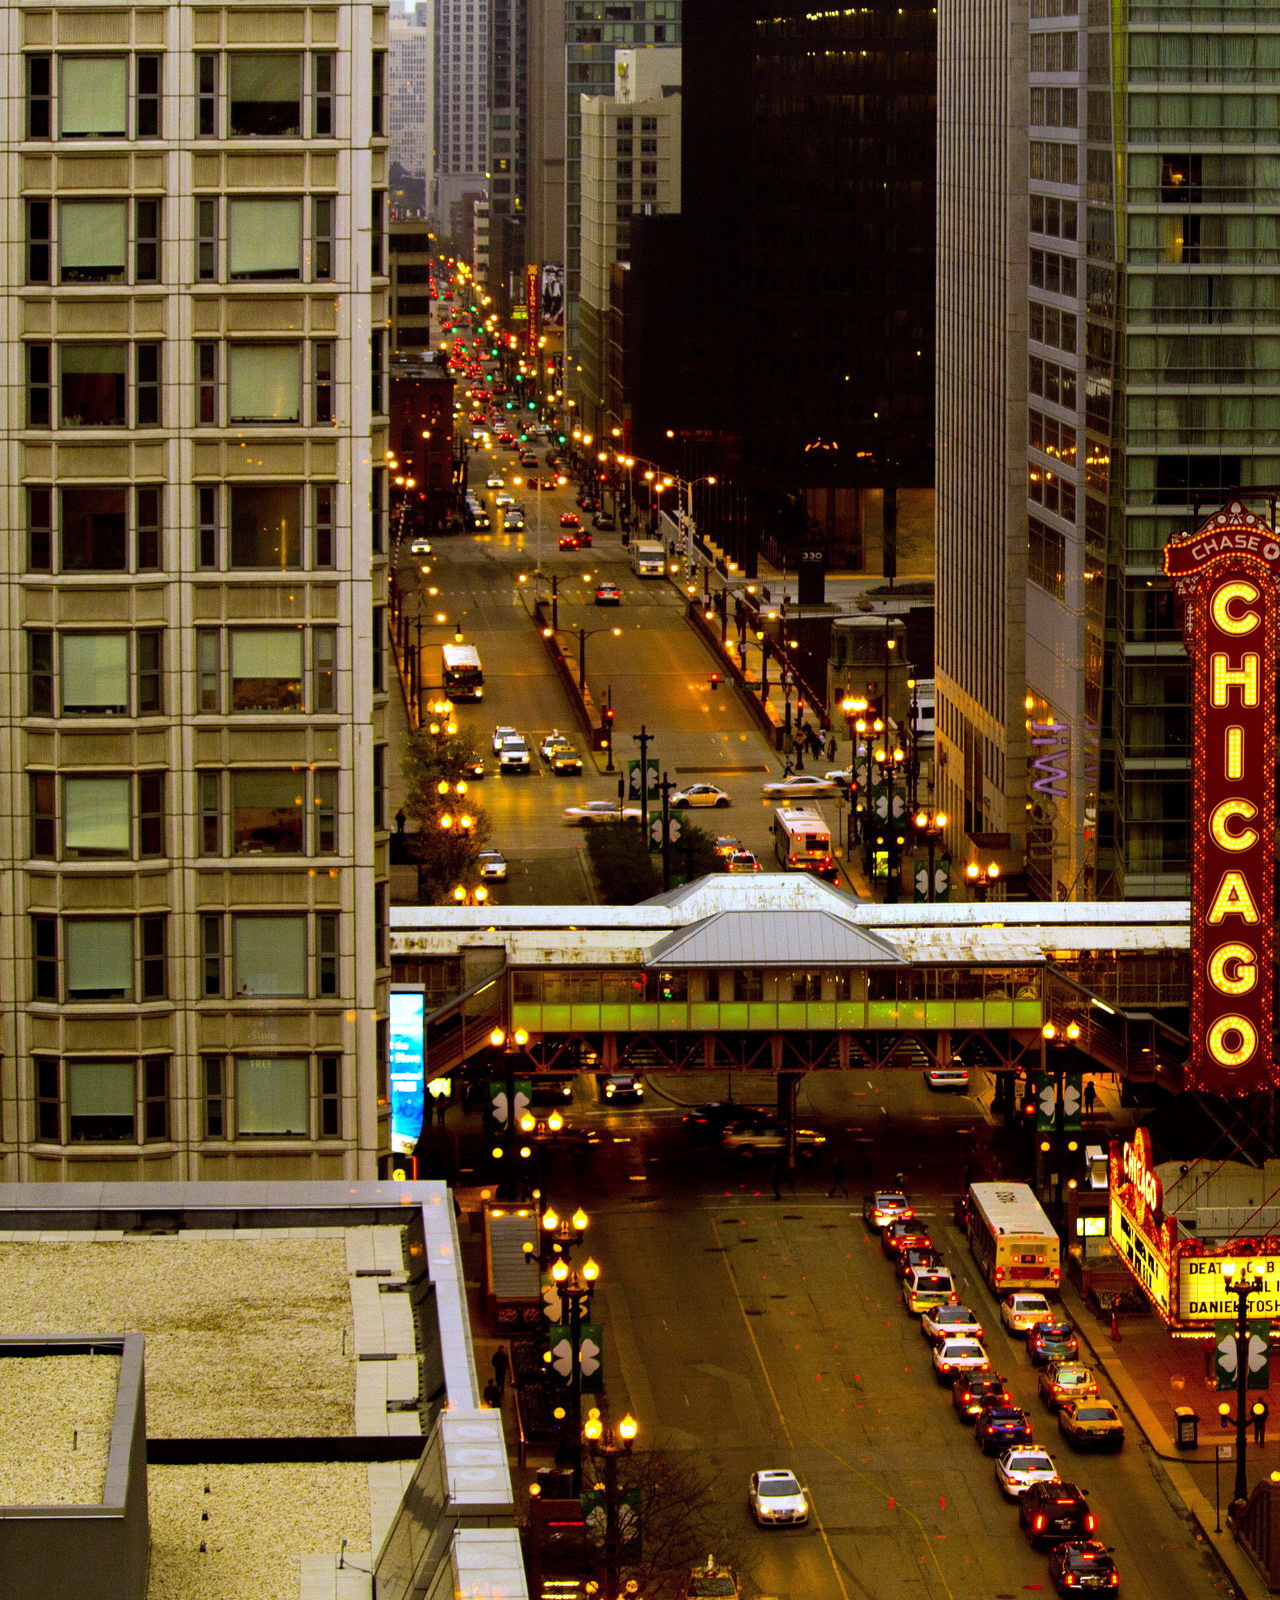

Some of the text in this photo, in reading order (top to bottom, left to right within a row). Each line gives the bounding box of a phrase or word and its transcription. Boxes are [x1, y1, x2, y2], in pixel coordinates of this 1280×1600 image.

[1191, 534, 1261, 561] CHASE
[1206, 580, 1261, 1068] CHICAGO
[1123, 1141, 1157, 1211] CHICAGO
[1190, 1262, 1232, 1275] DEAT
[1246, 1261, 1275, 1273] CB
[1190, 1300, 1239, 1313] DANIEL
